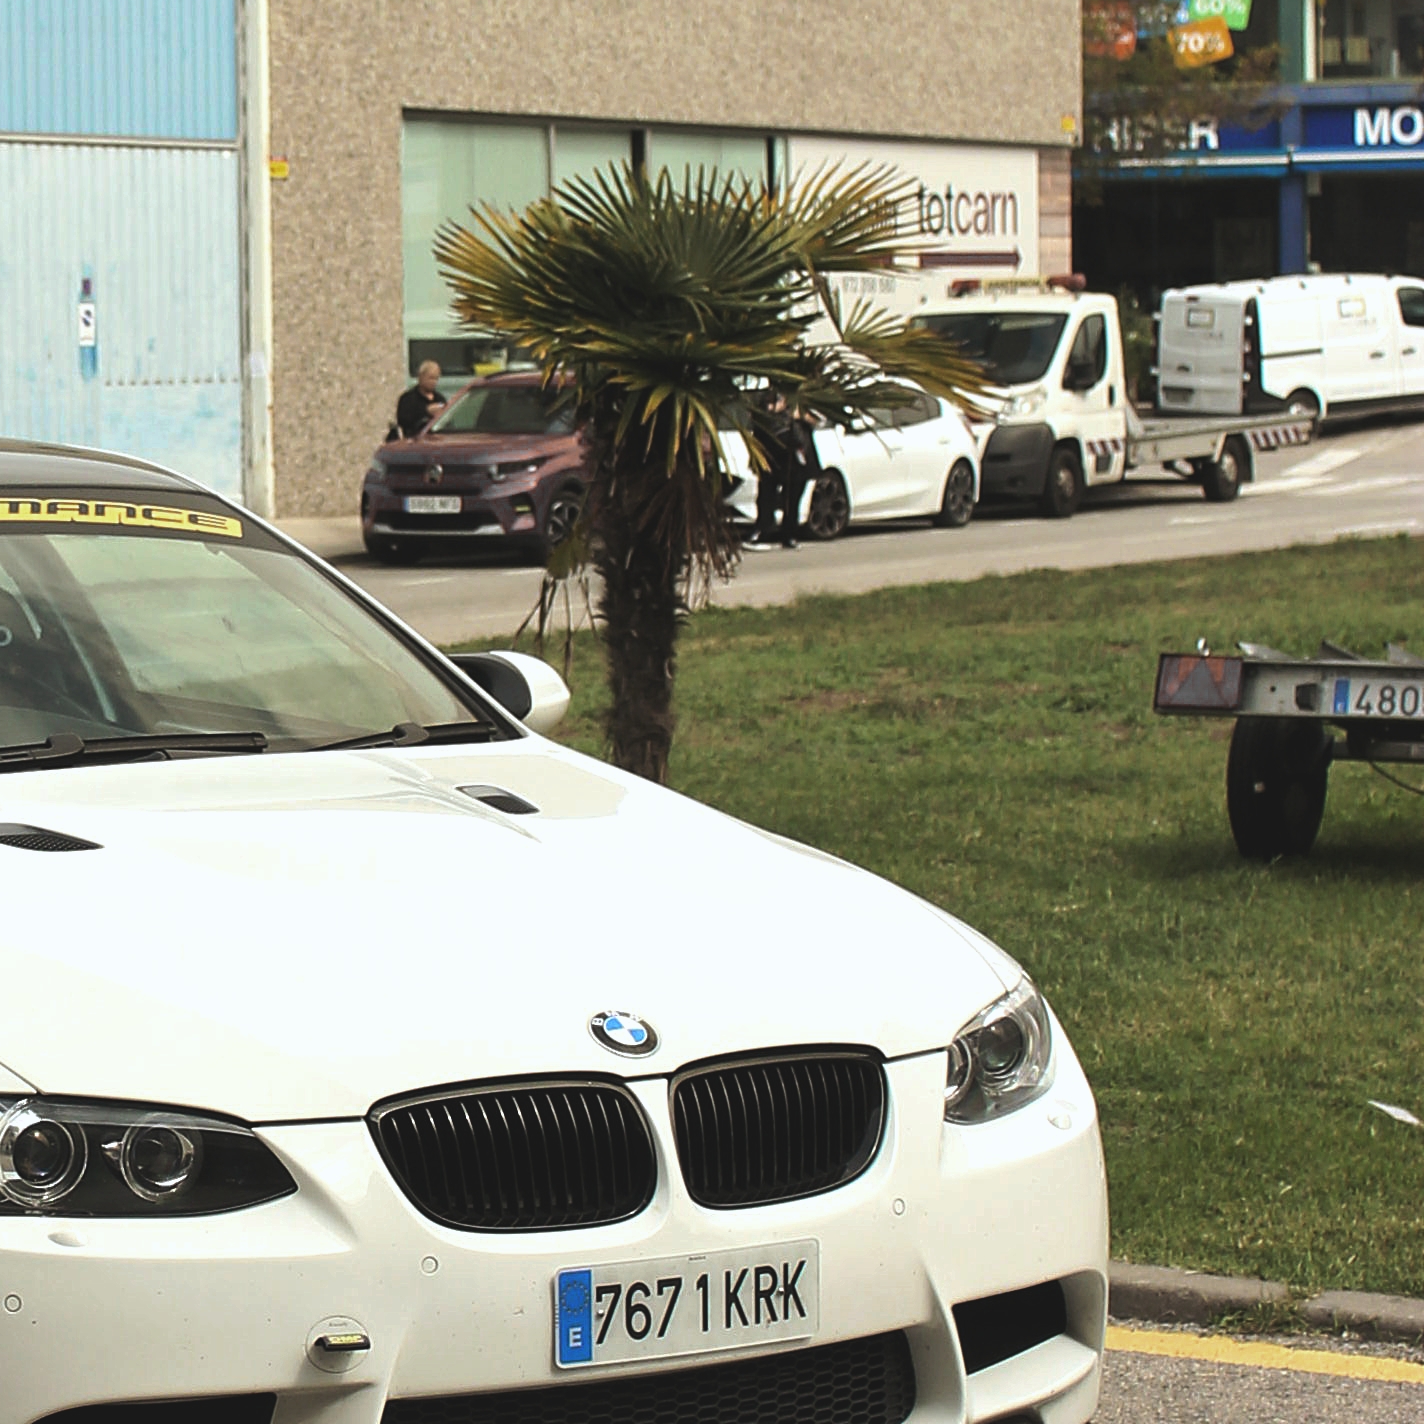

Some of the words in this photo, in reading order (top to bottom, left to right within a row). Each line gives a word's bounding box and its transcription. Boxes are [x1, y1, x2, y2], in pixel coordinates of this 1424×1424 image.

[1354, 106, 1424, 146] MO
[918, 183, 1018, 236] totcarn
[569, 1326, 582, 1348] E
